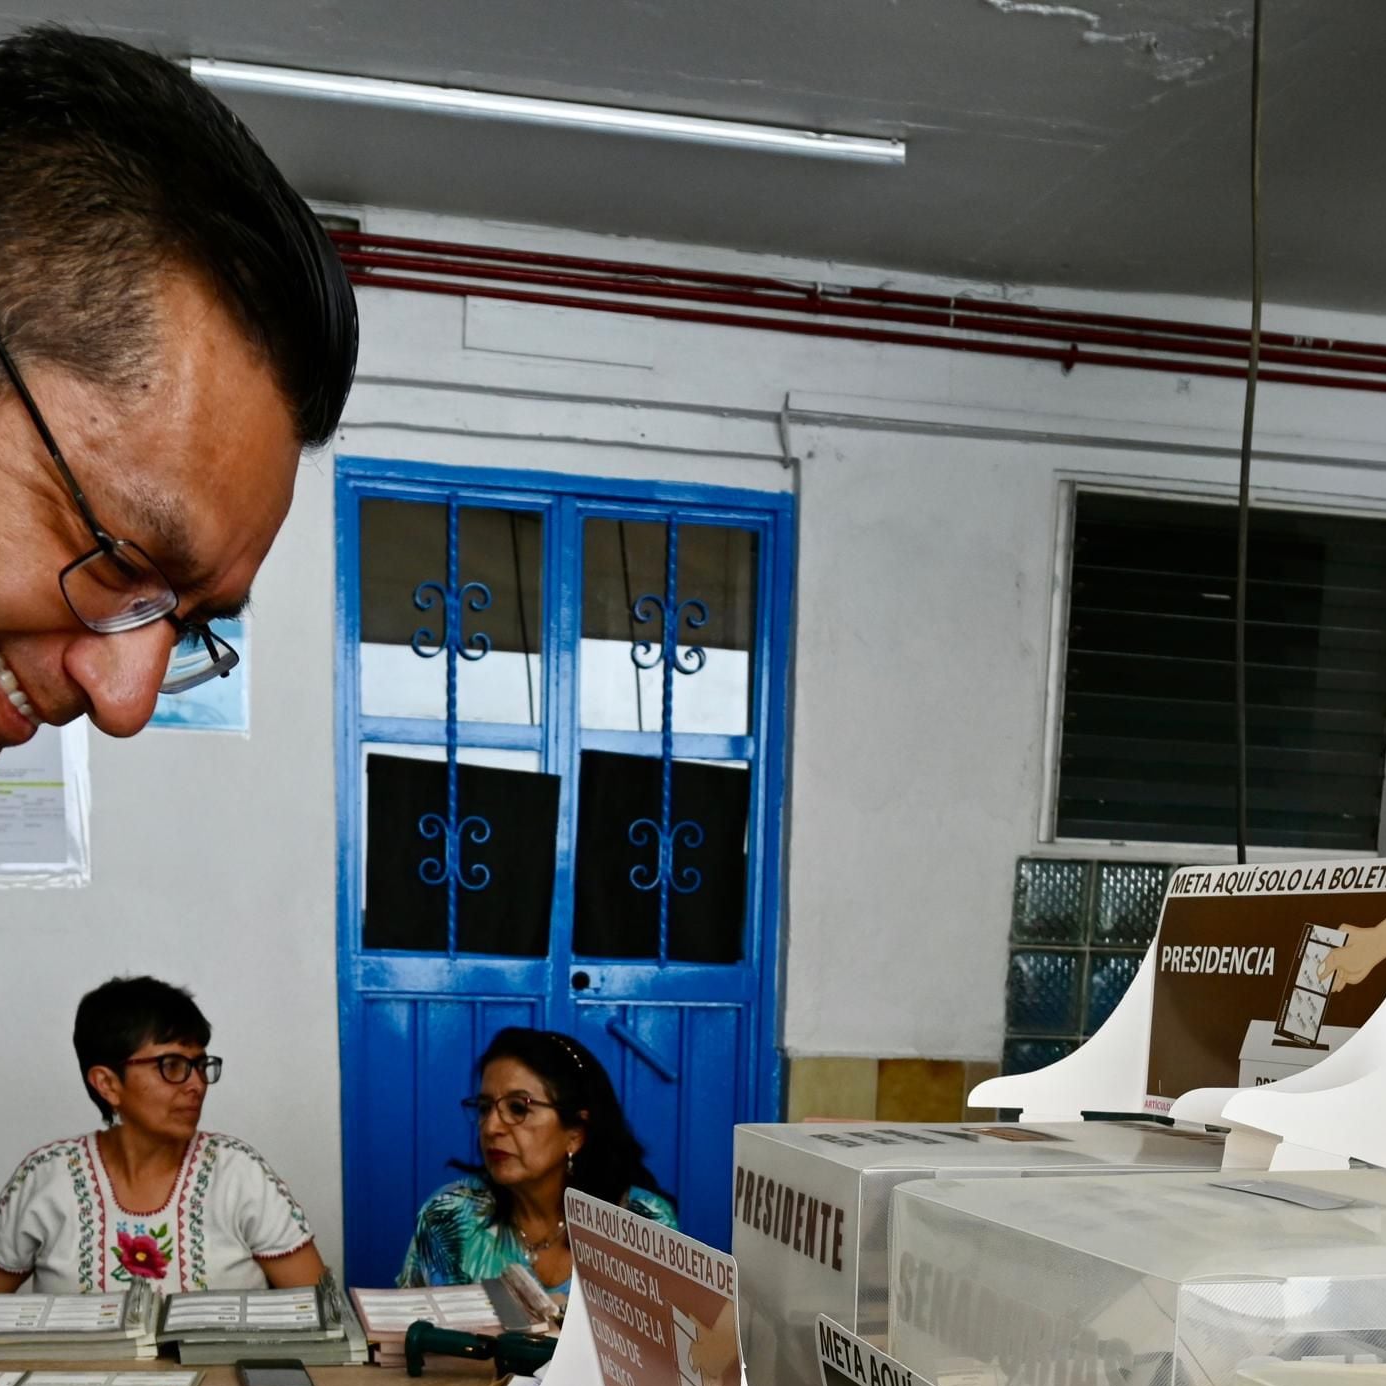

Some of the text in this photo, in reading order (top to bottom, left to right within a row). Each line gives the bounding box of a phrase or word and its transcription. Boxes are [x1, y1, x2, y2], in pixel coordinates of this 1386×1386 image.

[1170, 871, 1213, 895] META
[1212, 866, 1259, 896] AQUÍ
[1255, 868, 1304, 893] SOLO
[1303, 868, 1329, 892] LA
[1160, 945, 1276, 977] PRESIDENCIA
[566, 1195, 734, 1297] META AQUÍ SÓLO LA BOLETA DE
[733, 1165, 845, 1273] PRESIDENTE
[574, 1239, 663, 1306] DIPUTACIONES AL
[582, 1277, 667, 1349] CONGRESO DE LA
[590, 1315, 644, 1370] CIUDAD DE
[818, 1321, 867, 1385] META
